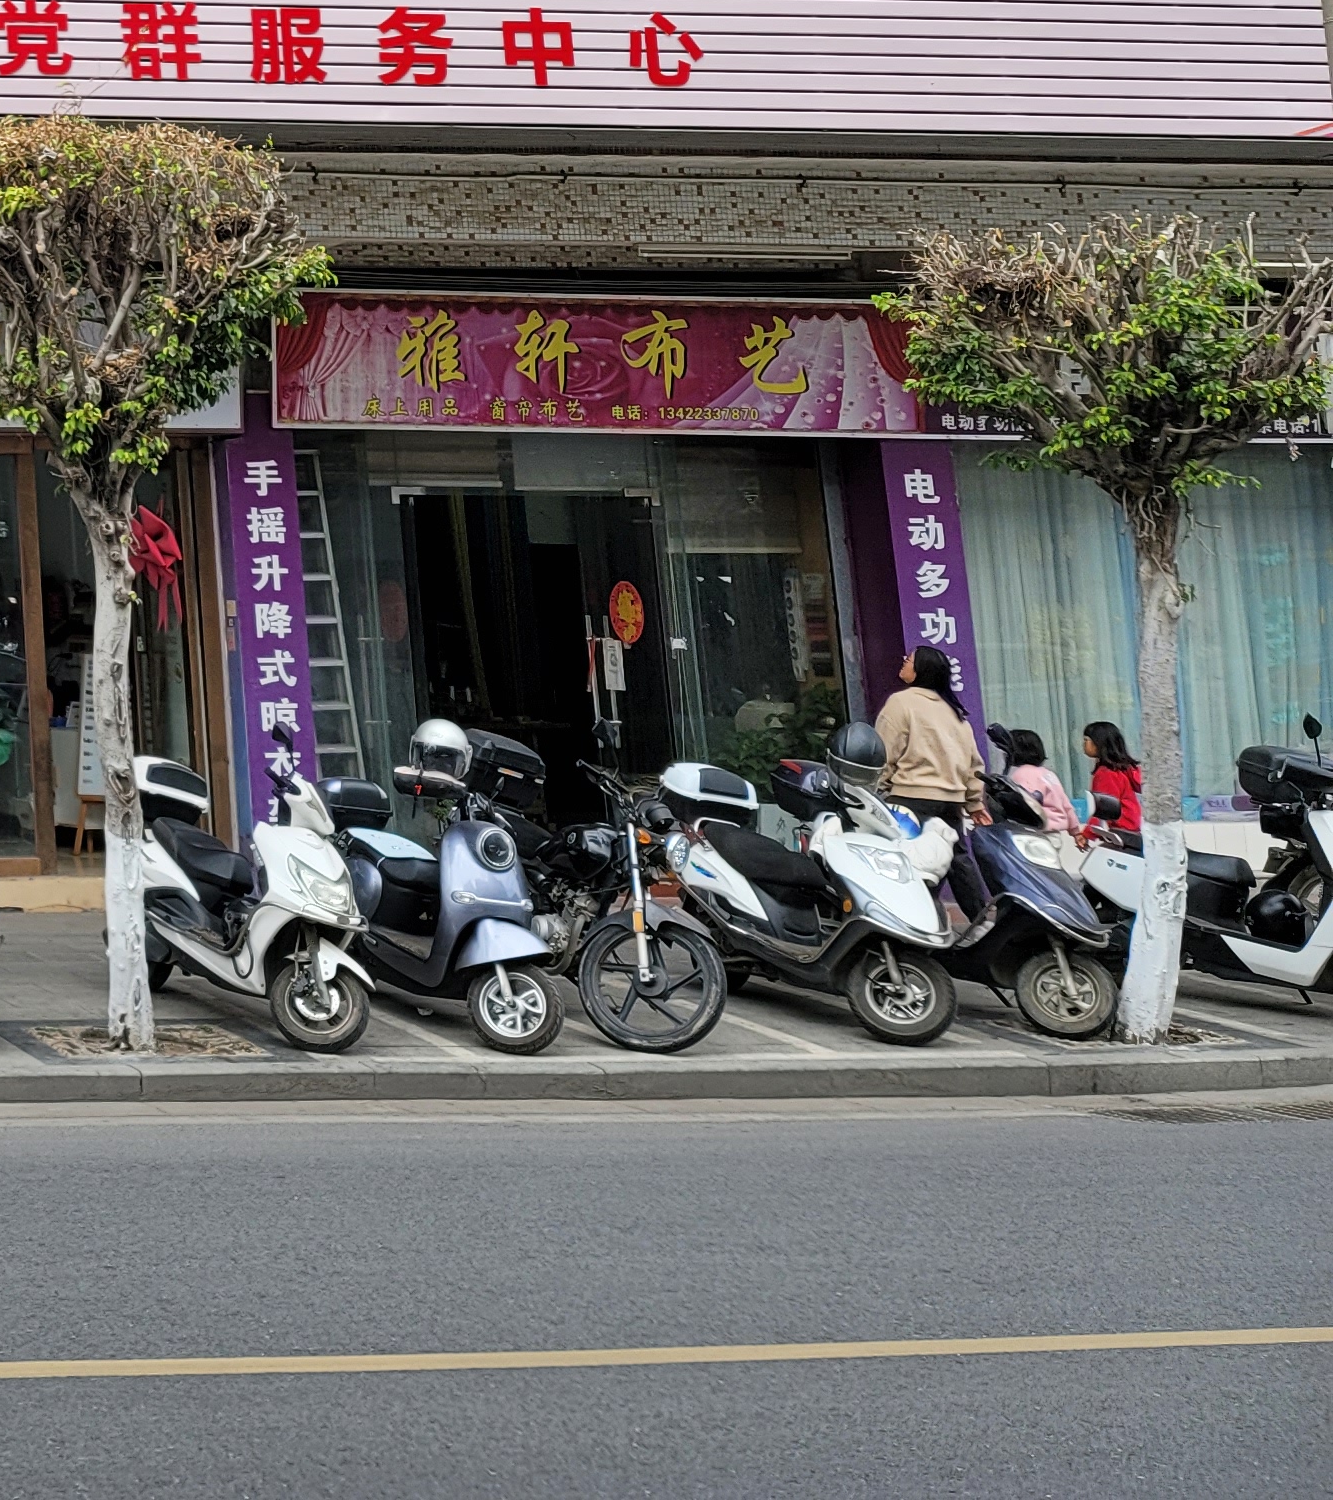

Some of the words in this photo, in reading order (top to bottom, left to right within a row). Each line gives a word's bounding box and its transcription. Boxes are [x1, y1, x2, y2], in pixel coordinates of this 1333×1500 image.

[397, 310, 809, 399] 雅轩布艺
[362, 397, 460, 418] 床上用品
